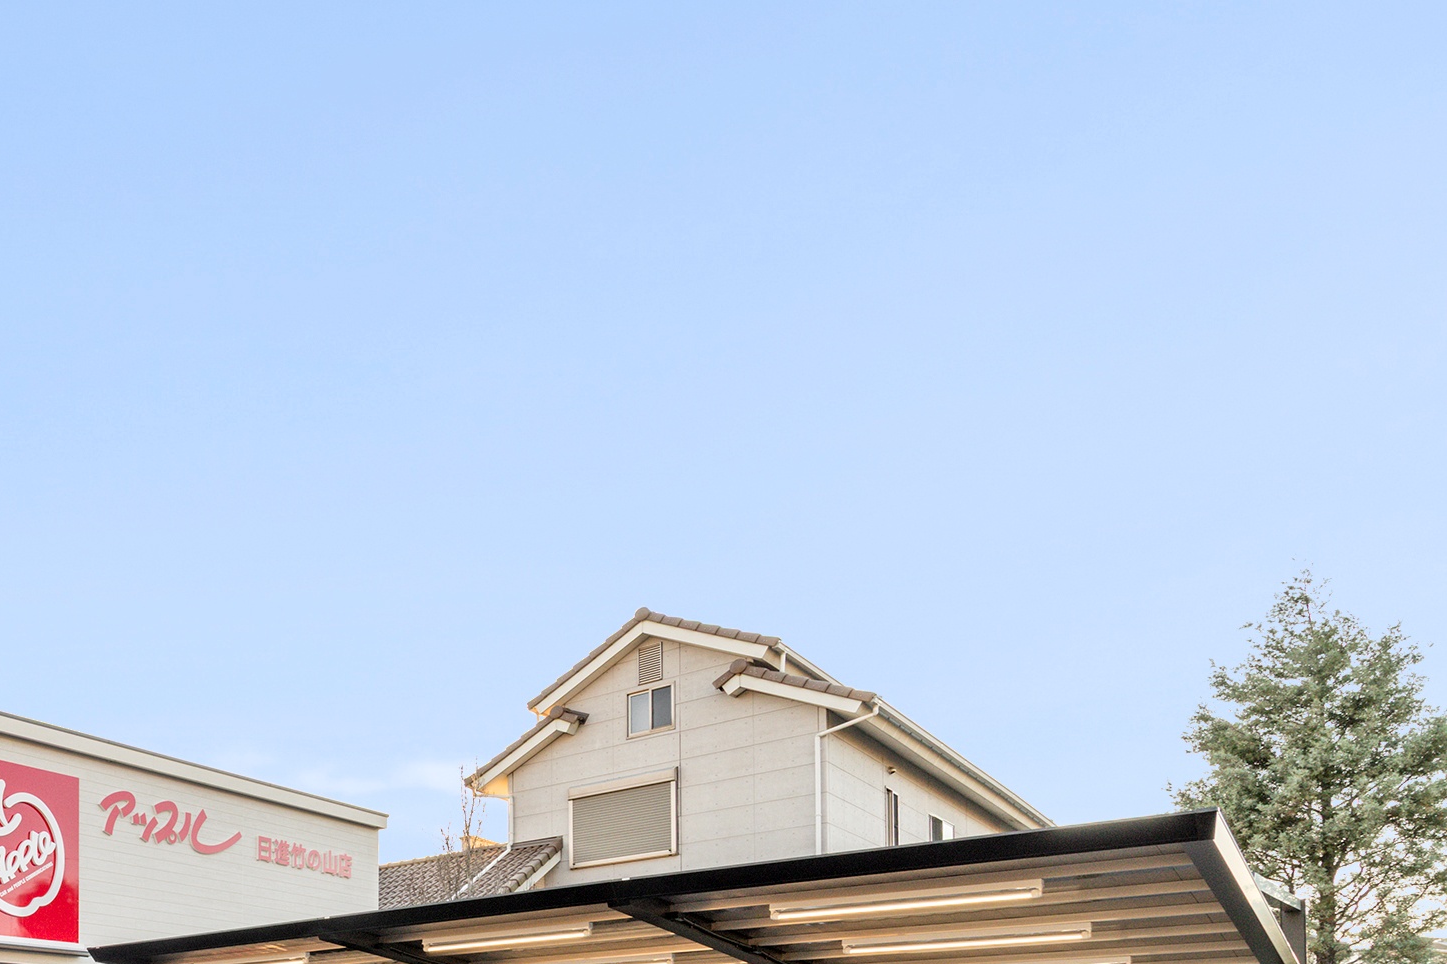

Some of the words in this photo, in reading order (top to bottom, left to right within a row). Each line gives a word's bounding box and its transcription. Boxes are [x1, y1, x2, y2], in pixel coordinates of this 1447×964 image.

[97, 790, 242, 855] アップル
[256, 835, 353, 879] 日進竹の山店
